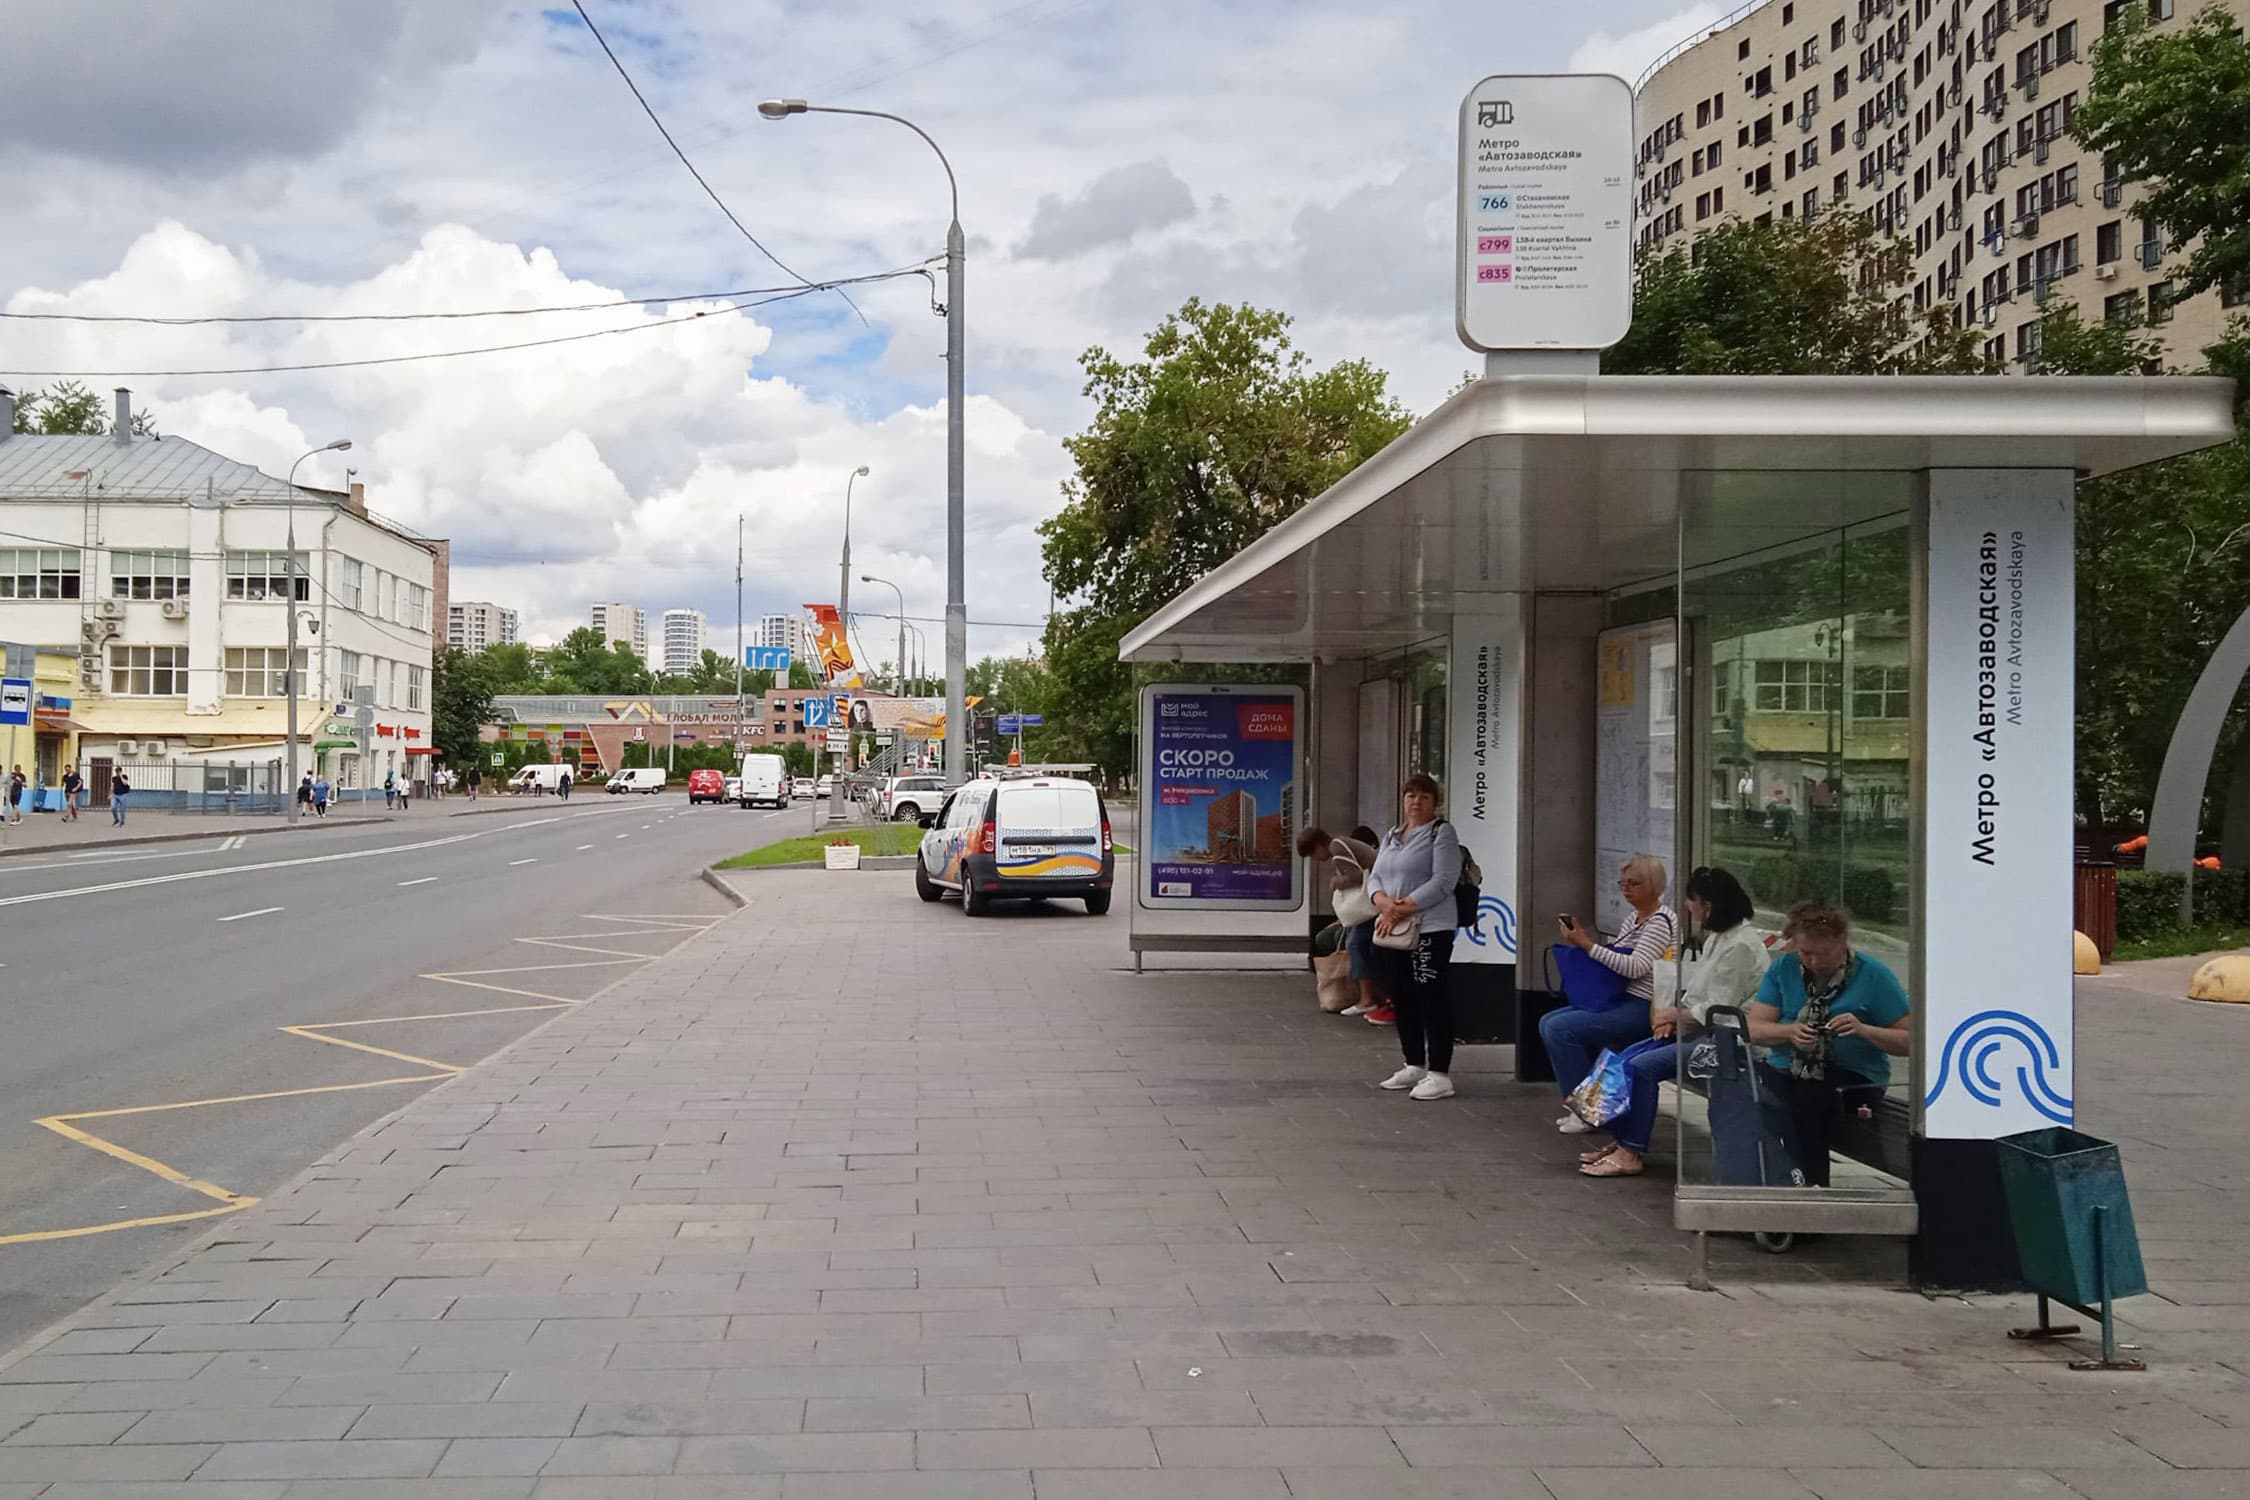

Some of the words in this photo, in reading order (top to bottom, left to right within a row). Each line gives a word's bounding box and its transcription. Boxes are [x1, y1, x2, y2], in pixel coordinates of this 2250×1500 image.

[1478, 138, 1520, 150] Метро
[1478, 150, 1582, 161] «Автозаводская»
[1478, 165, 1504, 173] Metro
[1505, 163, 1567, 172] Avtozavodskaya
[1482, 197, 1508, 209] 766
[1479, 239, 1509, 250] с799
[1479, 268, 1509, 280] с835
[2007, 530, 2027, 668] Avtozavodskaya
[1973, 531, 2000, 762] «Автозаводская»
[2007, 670, 2023, 726] Metro
[1474, 645, 1489, 767] «Автозаводская»
[667, 713, 709, 722] ГЛОБАЛ
[1251, 713, 1284, 722] ДОМА
[742, 726, 765, 735] KFC
[1248, 723, 1288, 733] СДАНЫ
[1491, 720, 1501, 749] Metro
[1160, 749, 1234, 766] СКОРО
[1160, 767, 1203, 779] СТАРТ
[1206, 768, 1269, 780] ПРОДАЖ
[1473, 771, 1489, 820] Метро
[1972, 773, 2000, 866] Метро
